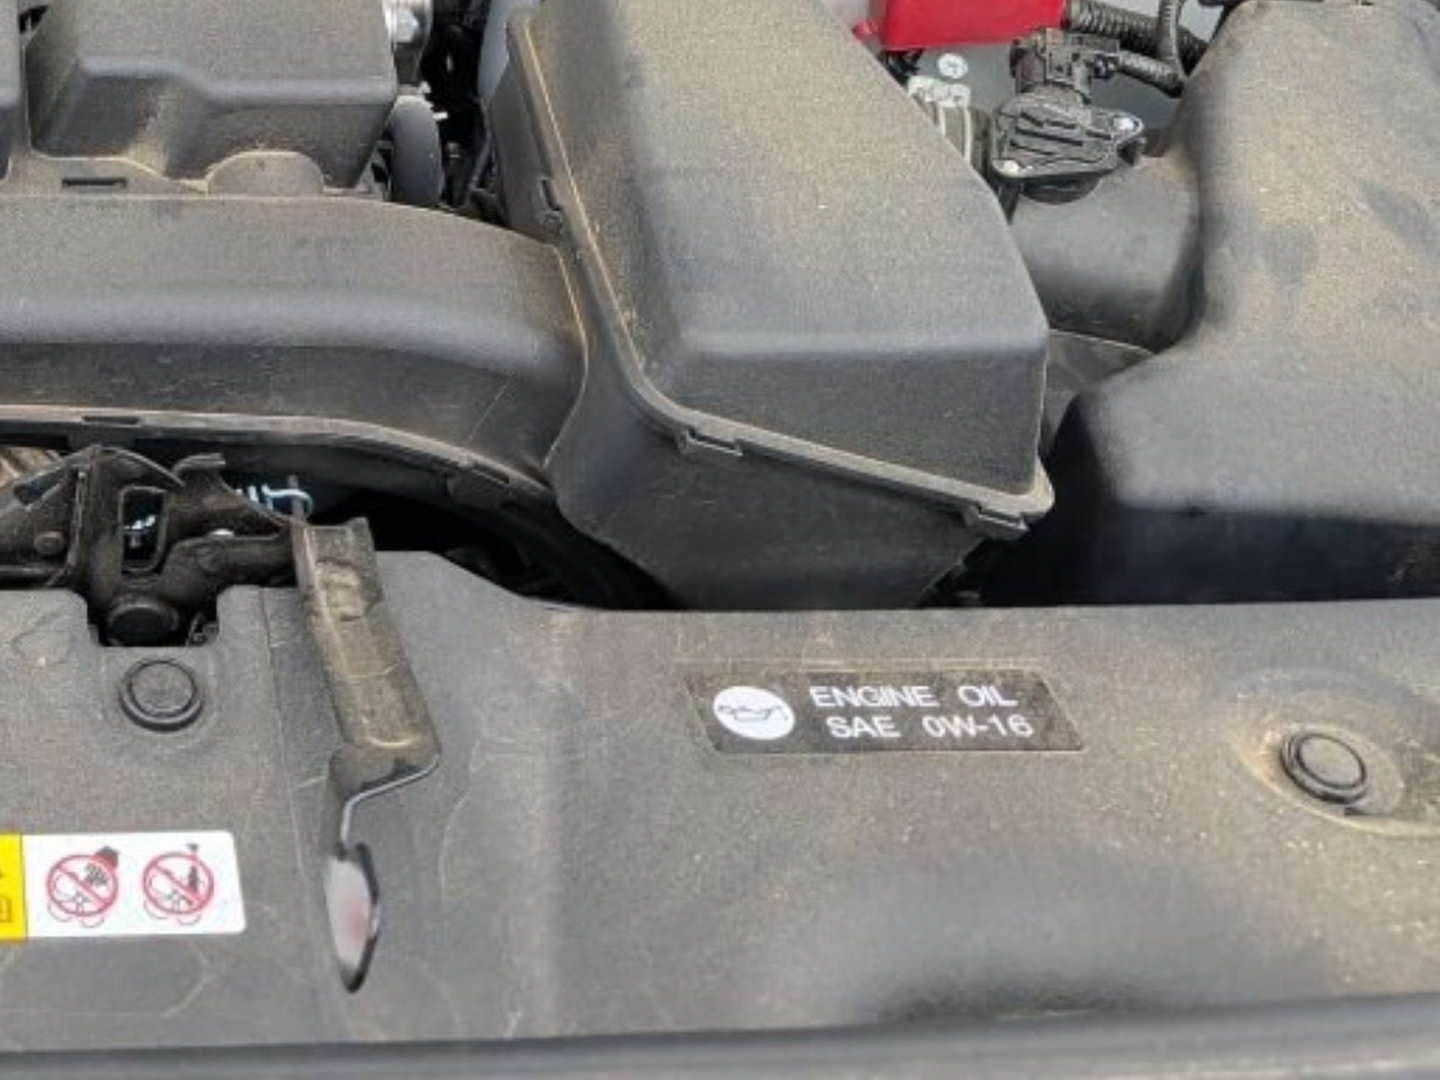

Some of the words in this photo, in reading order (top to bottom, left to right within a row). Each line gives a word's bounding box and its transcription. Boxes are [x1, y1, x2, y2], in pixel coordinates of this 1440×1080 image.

[809, 685, 939, 708] ENGINE
[958, 685, 1018, 708] OIL
[825, 716, 901, 739] SAE
[921, 715, 1035, 739] 0W-16
